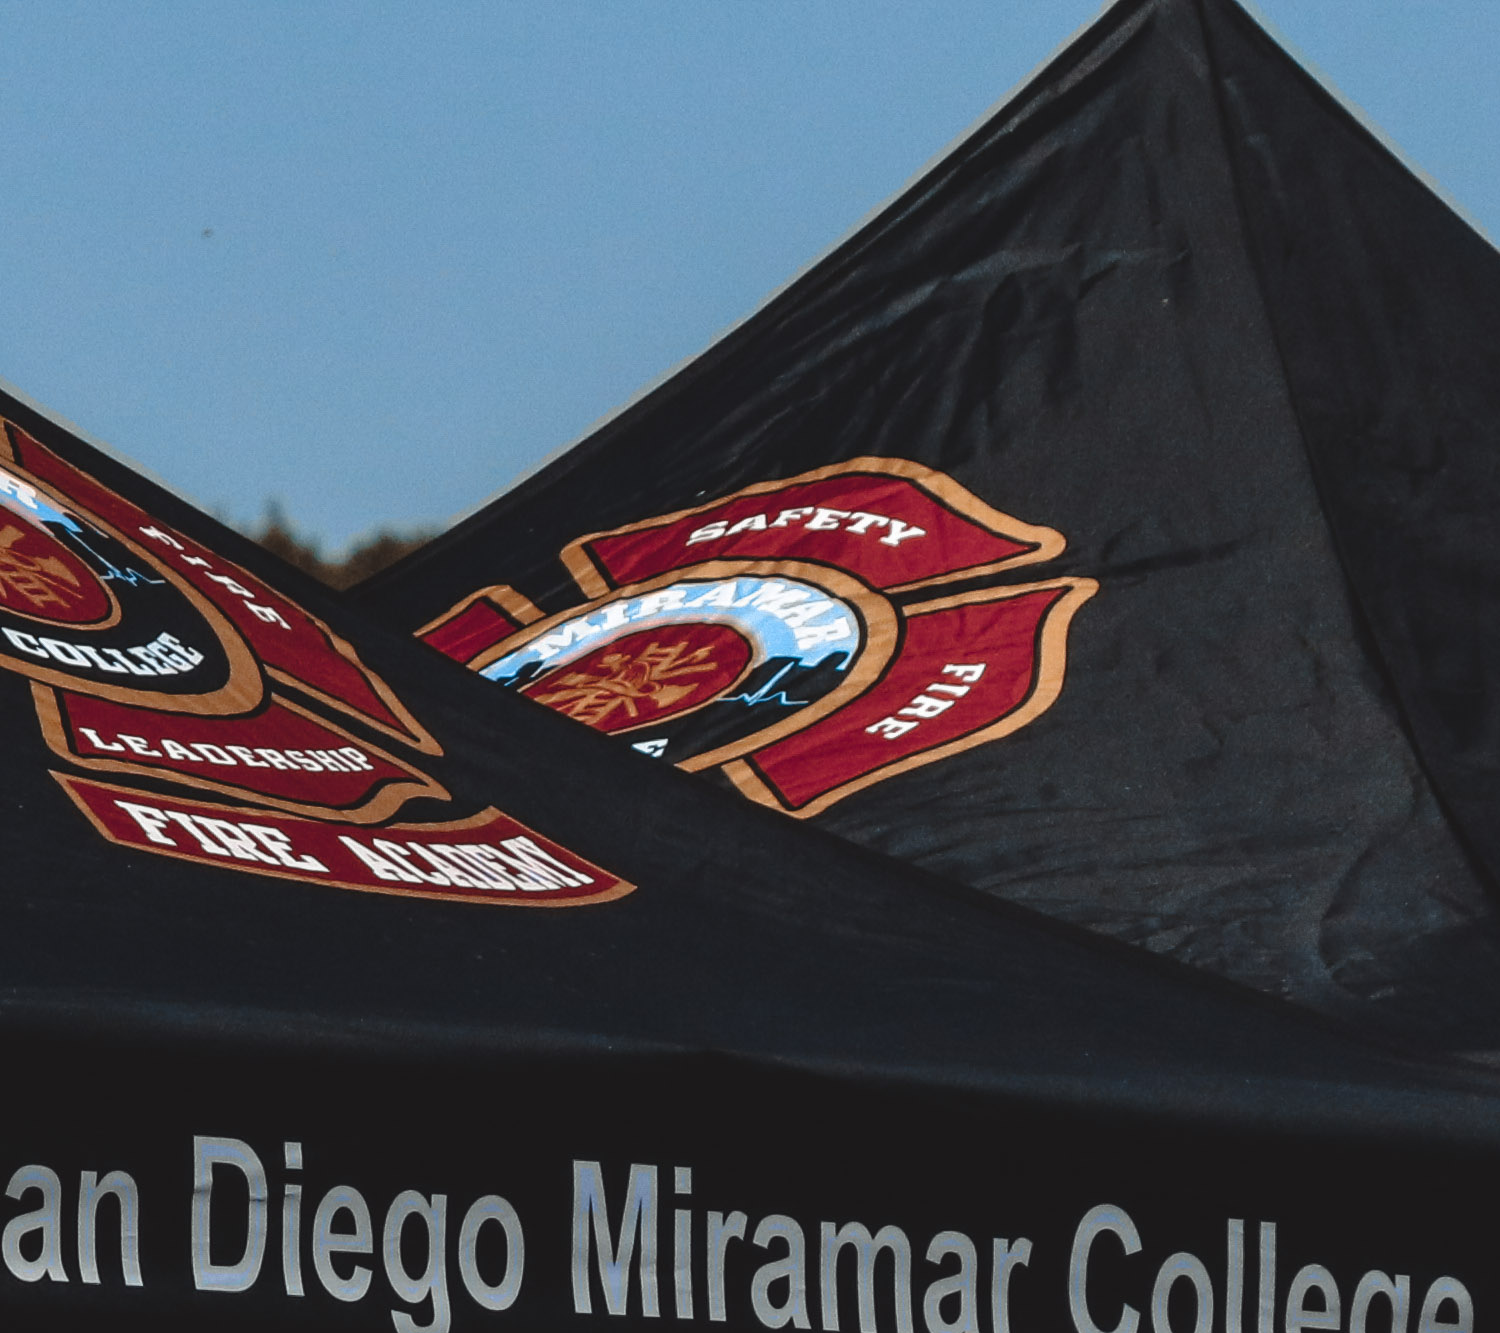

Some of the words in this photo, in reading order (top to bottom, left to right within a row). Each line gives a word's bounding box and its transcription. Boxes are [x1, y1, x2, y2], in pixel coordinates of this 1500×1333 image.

[685, 506, 927, 549] SAFETY
[0, 625, 206, 678] COLLEGE
[532, 577, 855, 661] MIRAMAR
[866, 661, 987, 742] FIRE
[79, 726, 375, 773] LEADERSHIP
[112, 799, 331, 874] FIRE
[337, 834, 595, 892] ACADEMY
